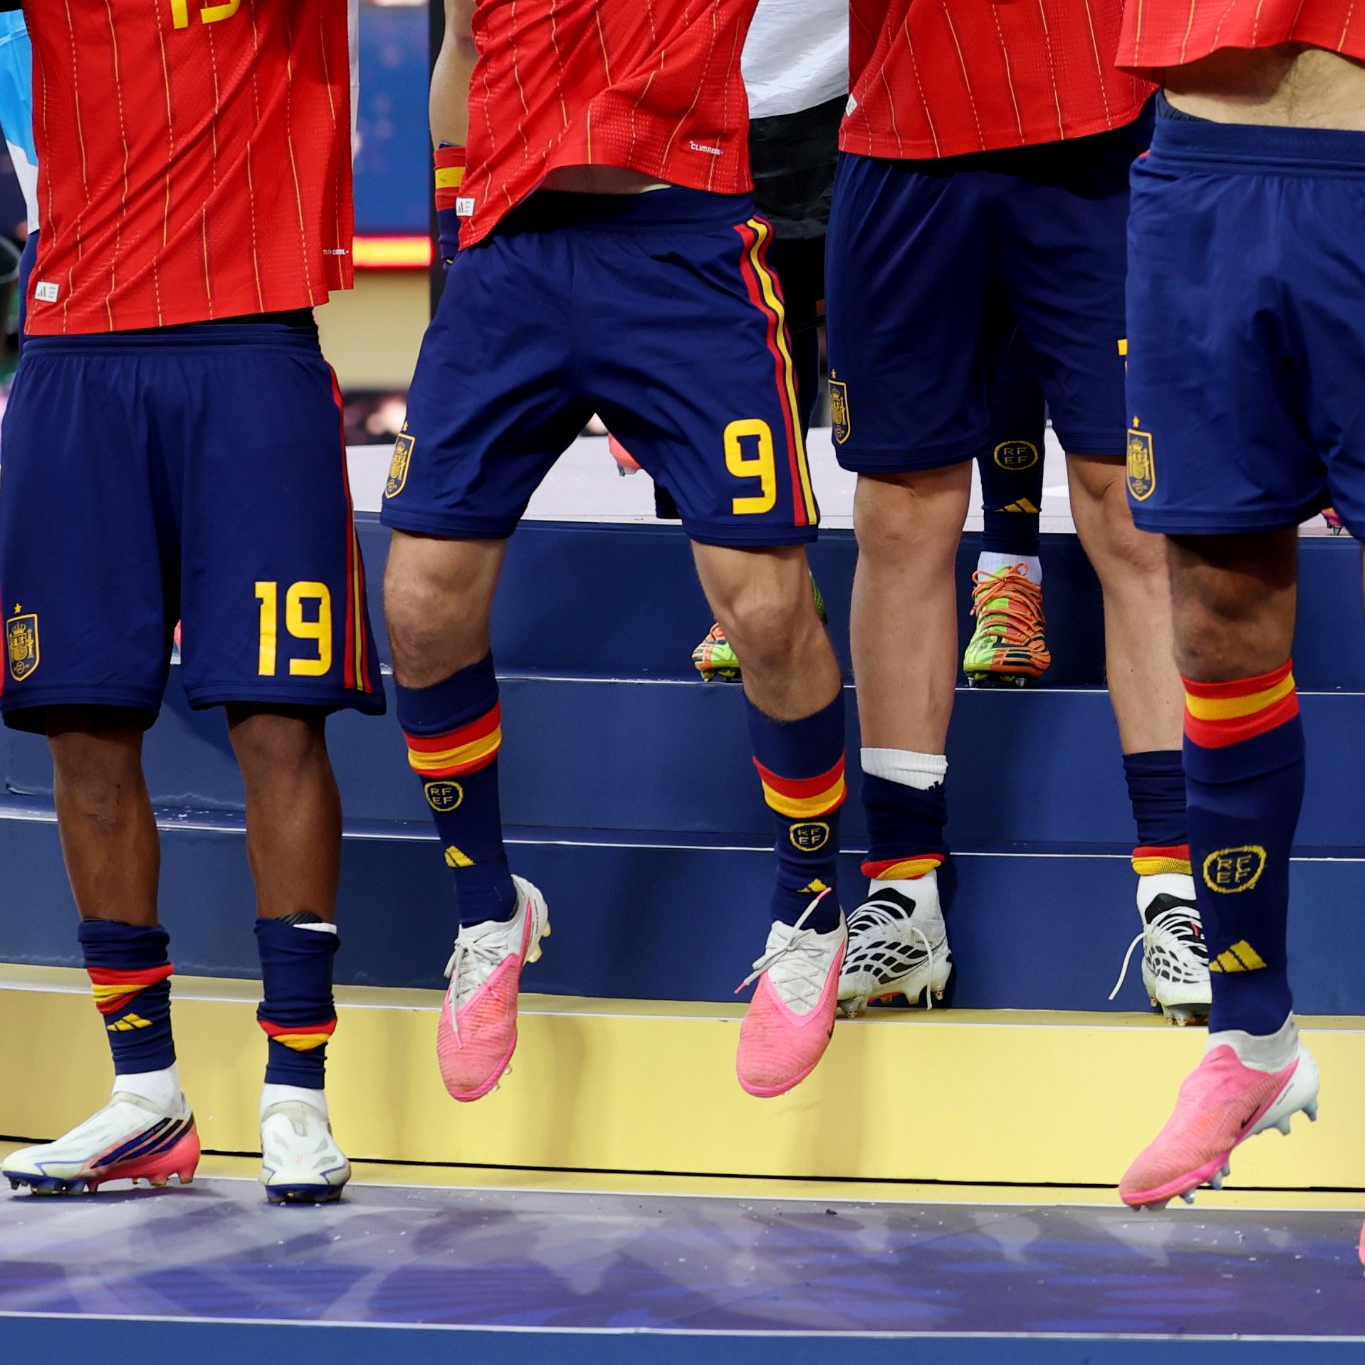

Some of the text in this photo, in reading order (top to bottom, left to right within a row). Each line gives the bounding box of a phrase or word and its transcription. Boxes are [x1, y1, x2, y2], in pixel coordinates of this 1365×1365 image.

[722, 417, 778, 516] 9
[253, 580, 334, 677] 19
[430, 787, 453, 796] RF
[432, 796, 454, 805] EF
